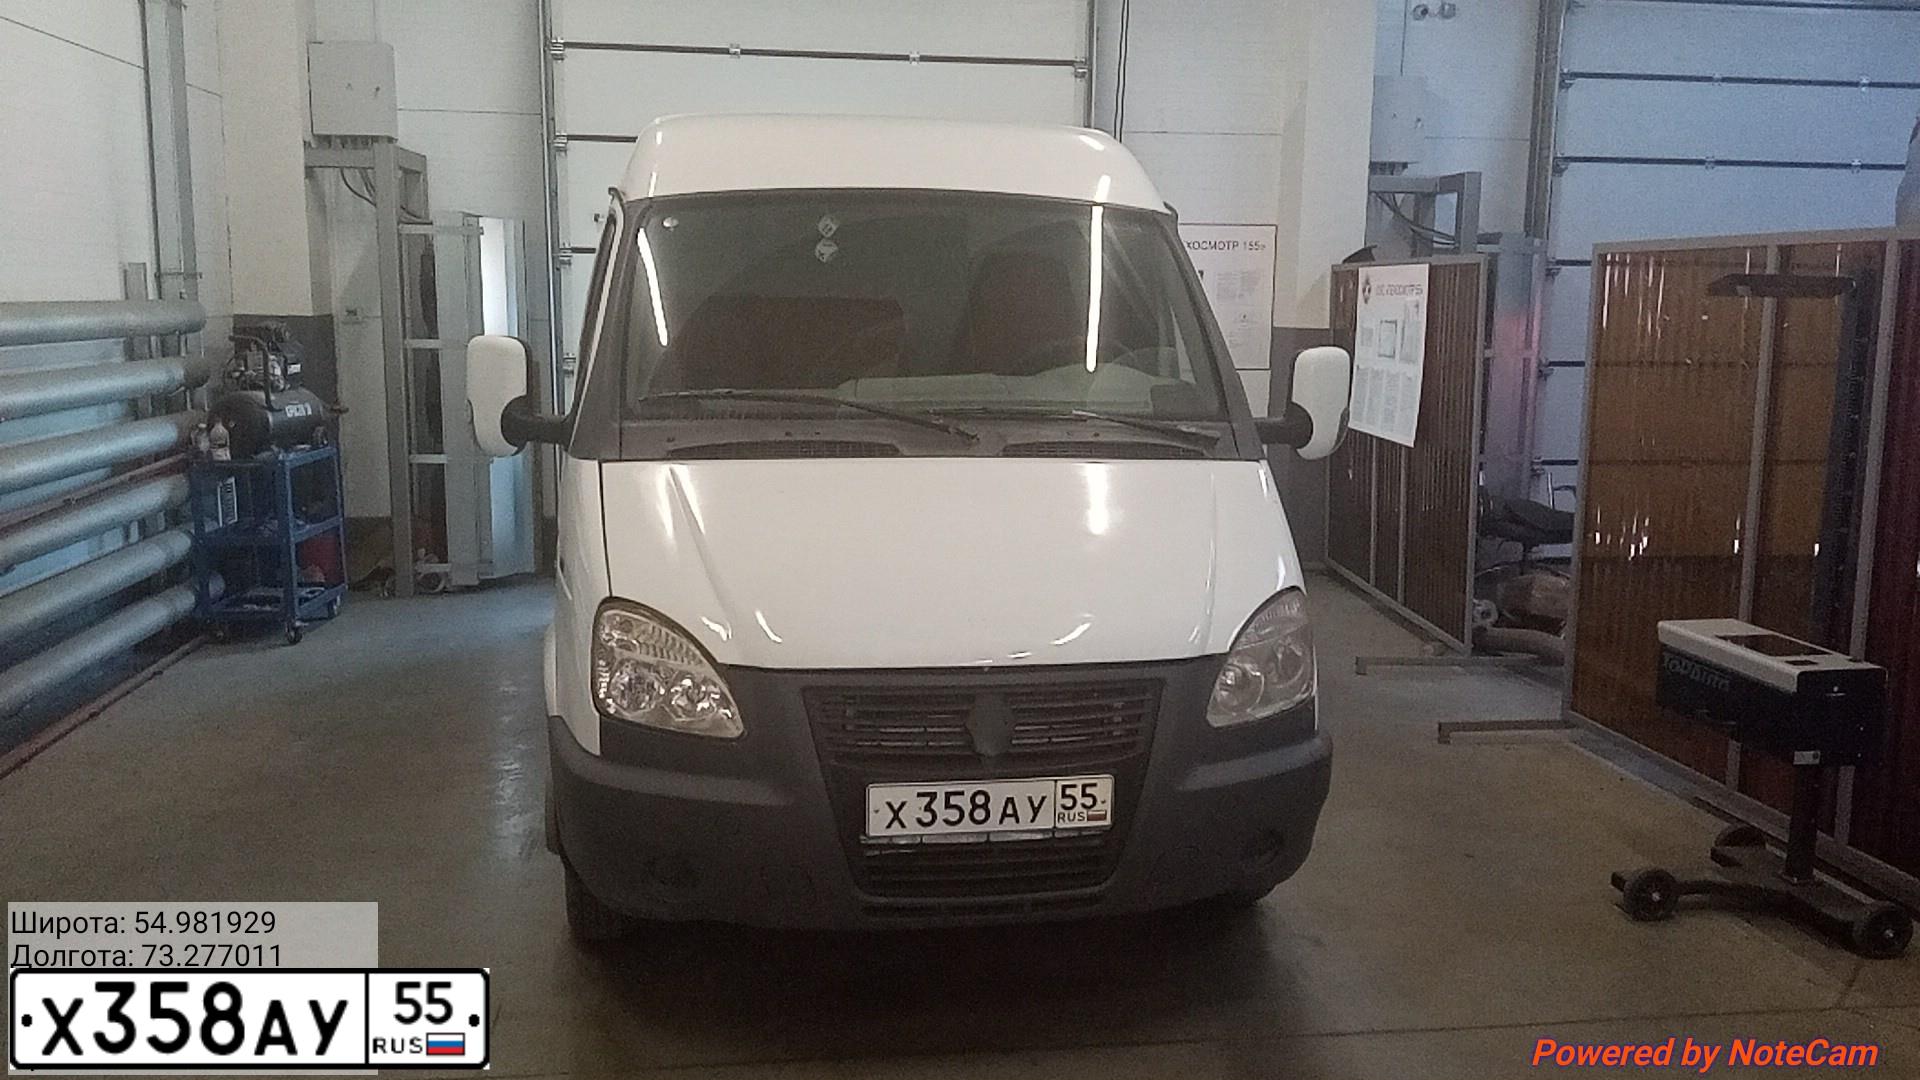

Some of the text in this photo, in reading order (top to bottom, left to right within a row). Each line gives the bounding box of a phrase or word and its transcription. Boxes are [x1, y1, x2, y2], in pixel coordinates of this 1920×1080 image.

[885, 782, 1098, 829] Х358АУ 55
[1057, 811, 1086, 823] RUS
